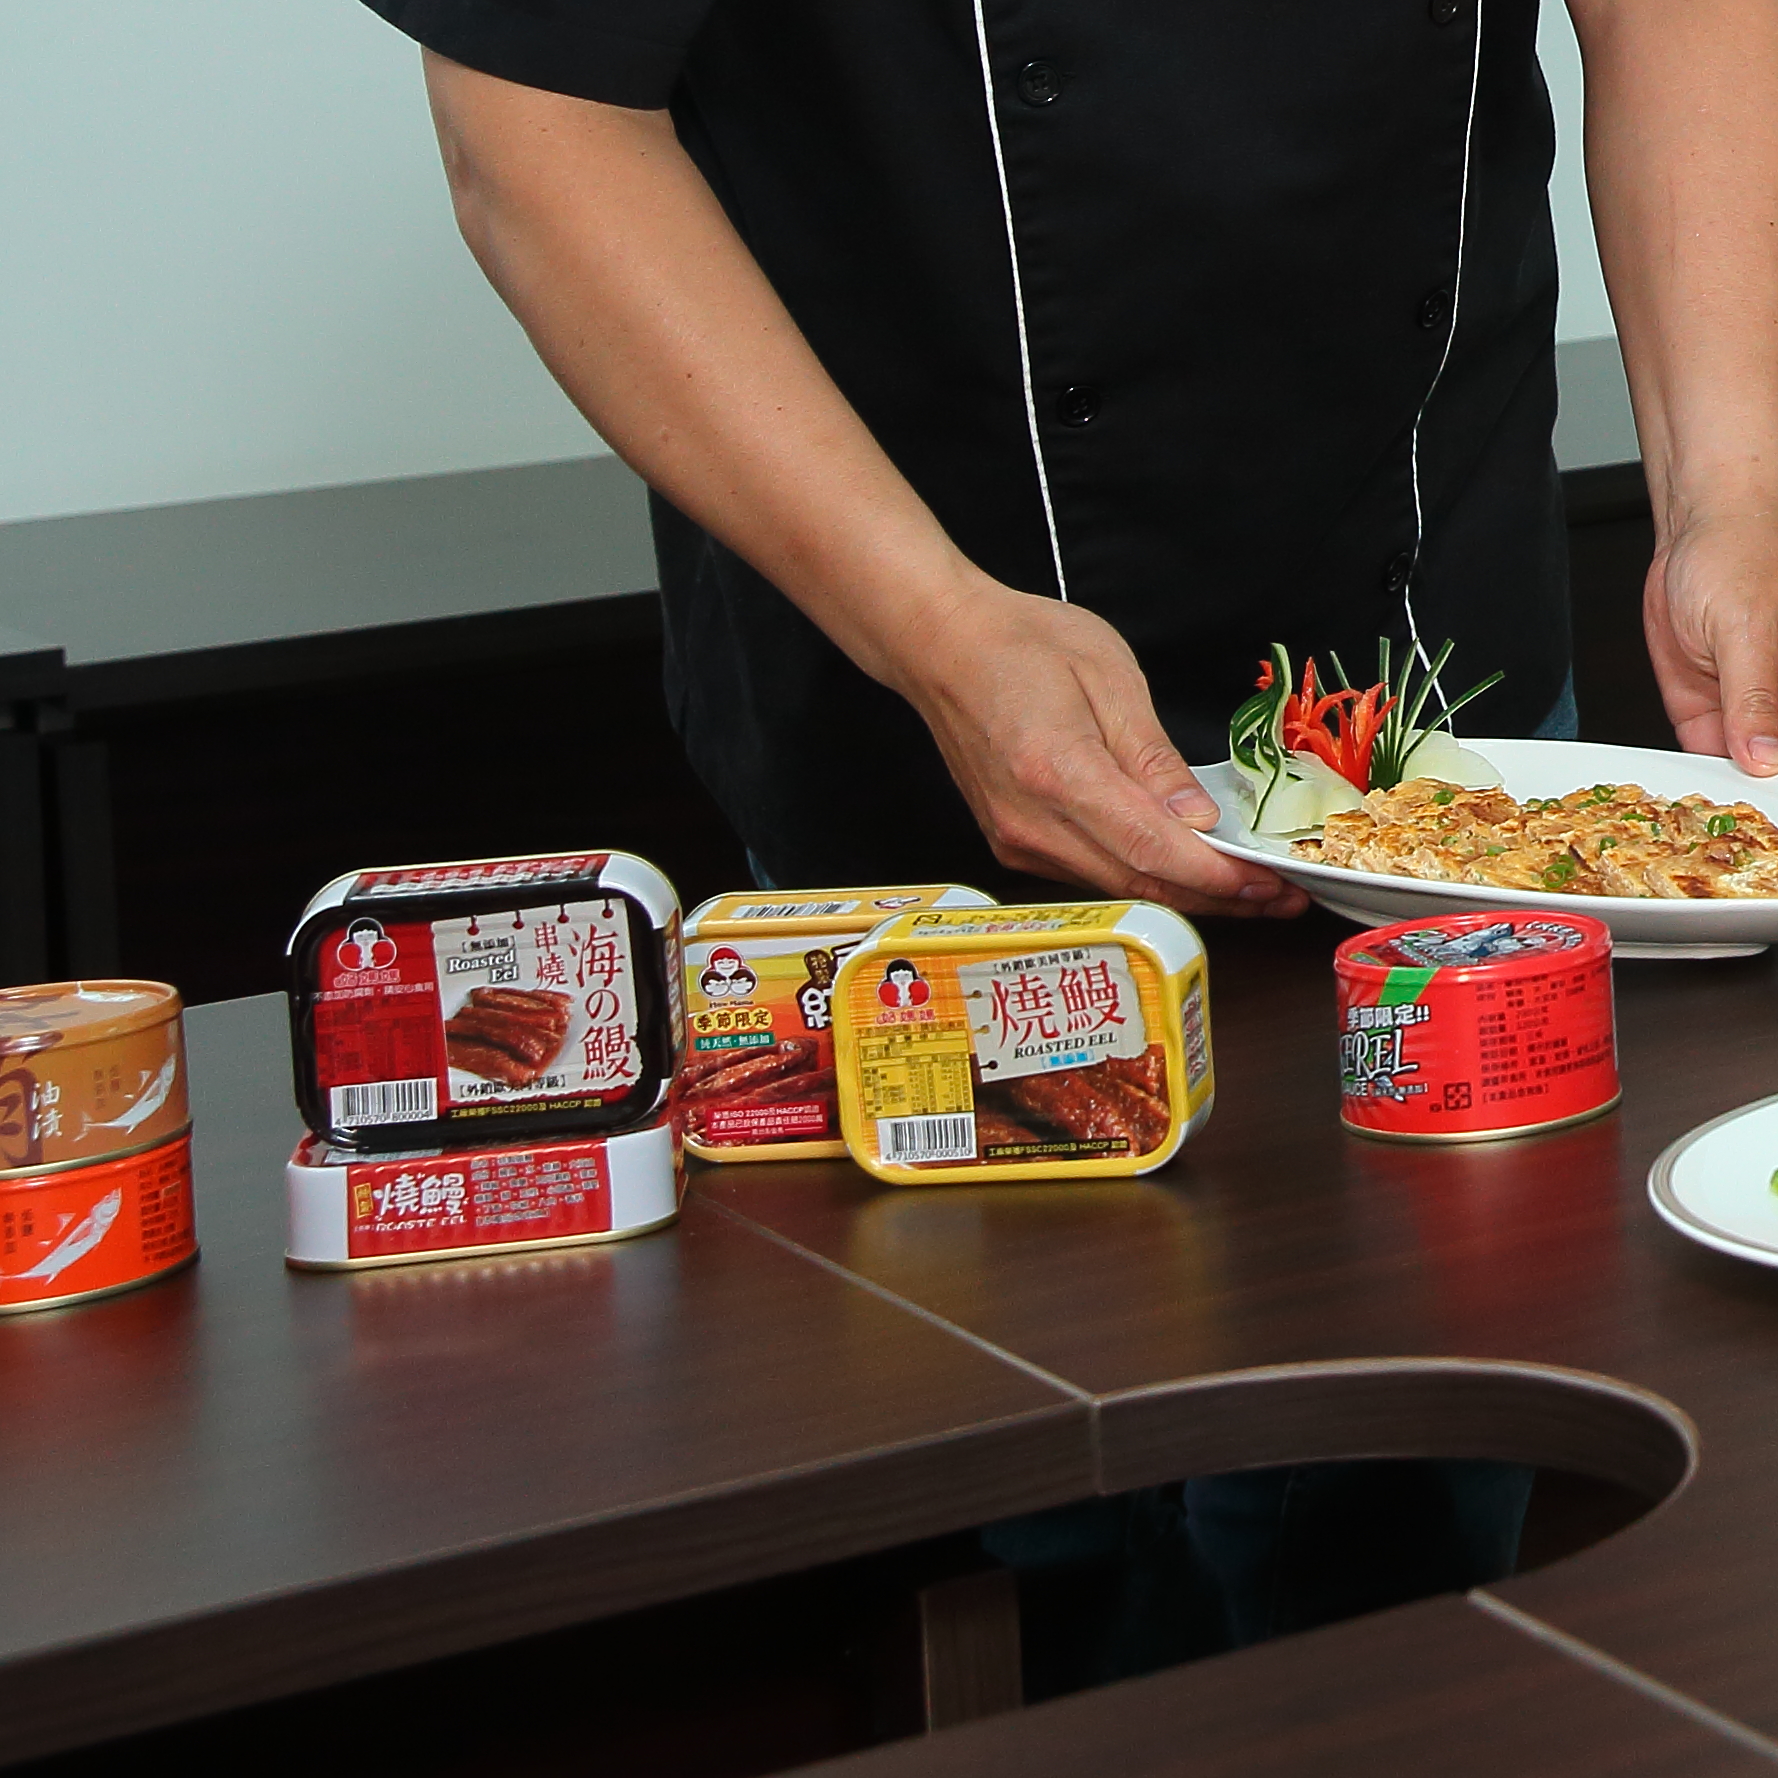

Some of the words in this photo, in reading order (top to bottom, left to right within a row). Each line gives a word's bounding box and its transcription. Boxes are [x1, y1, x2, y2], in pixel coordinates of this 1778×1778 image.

[447, 948, 516, 973] Roasted
[490, 964, 519, 983] Eel
[567, 923, 636, 1081] 海の鰻
[990, 959, 1128, 1049] 燒鰻
[697, 1009, 770, 1031] 季節限定
[1014, 1038, 1086, 1059] ROASTED
[1088, 1032, 1118, 1048] EEL
[31, 1080, 63, 1142] 油漬
[373, 1173, 467, 1217] 燒鰻
